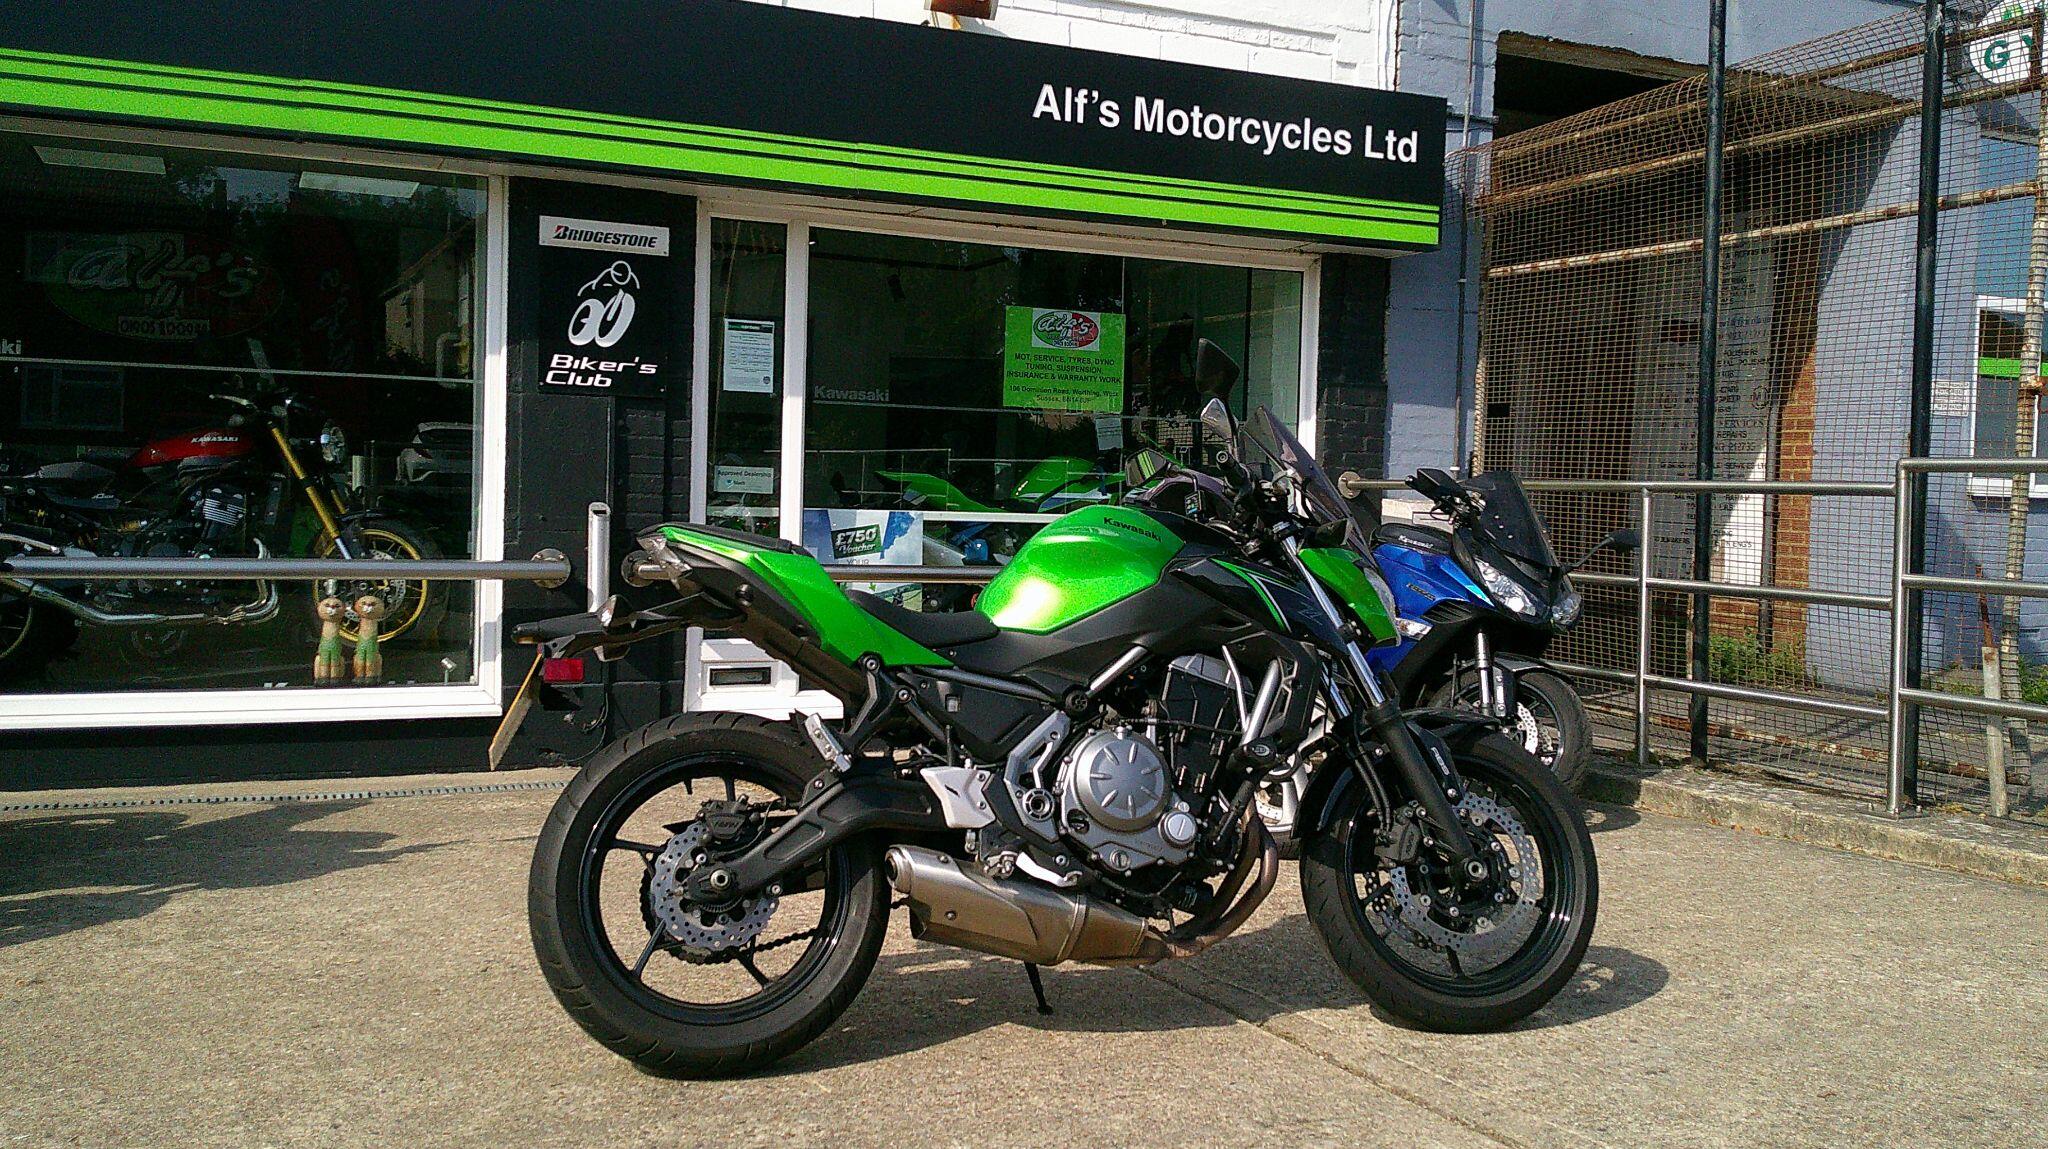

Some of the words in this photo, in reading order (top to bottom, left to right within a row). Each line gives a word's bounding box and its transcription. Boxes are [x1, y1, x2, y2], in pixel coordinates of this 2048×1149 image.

[1032, 83, 1120, 128] Alf's
[1134, 96, 1352, 156] Motorcycles
[1364, 124, 1418, 163] Ltd
[552, 224, 658, 249] BRIDGESTONE
[550, 353, 658, 375] Biker's
[545, 370, 613, 388] Club
[1006, 371, 1049, 380] INSURANCE
[1058, 374, 1098, 383] WARRANTY
[813, 384, 890, 402] Kawasaki
[191, 436, 239, 444] KAWASAKI
[835, 528, 877, 547] £750
[1103, 516, 1162, 543] Kawasaki
[839, 543, 876, 555] Voucher
